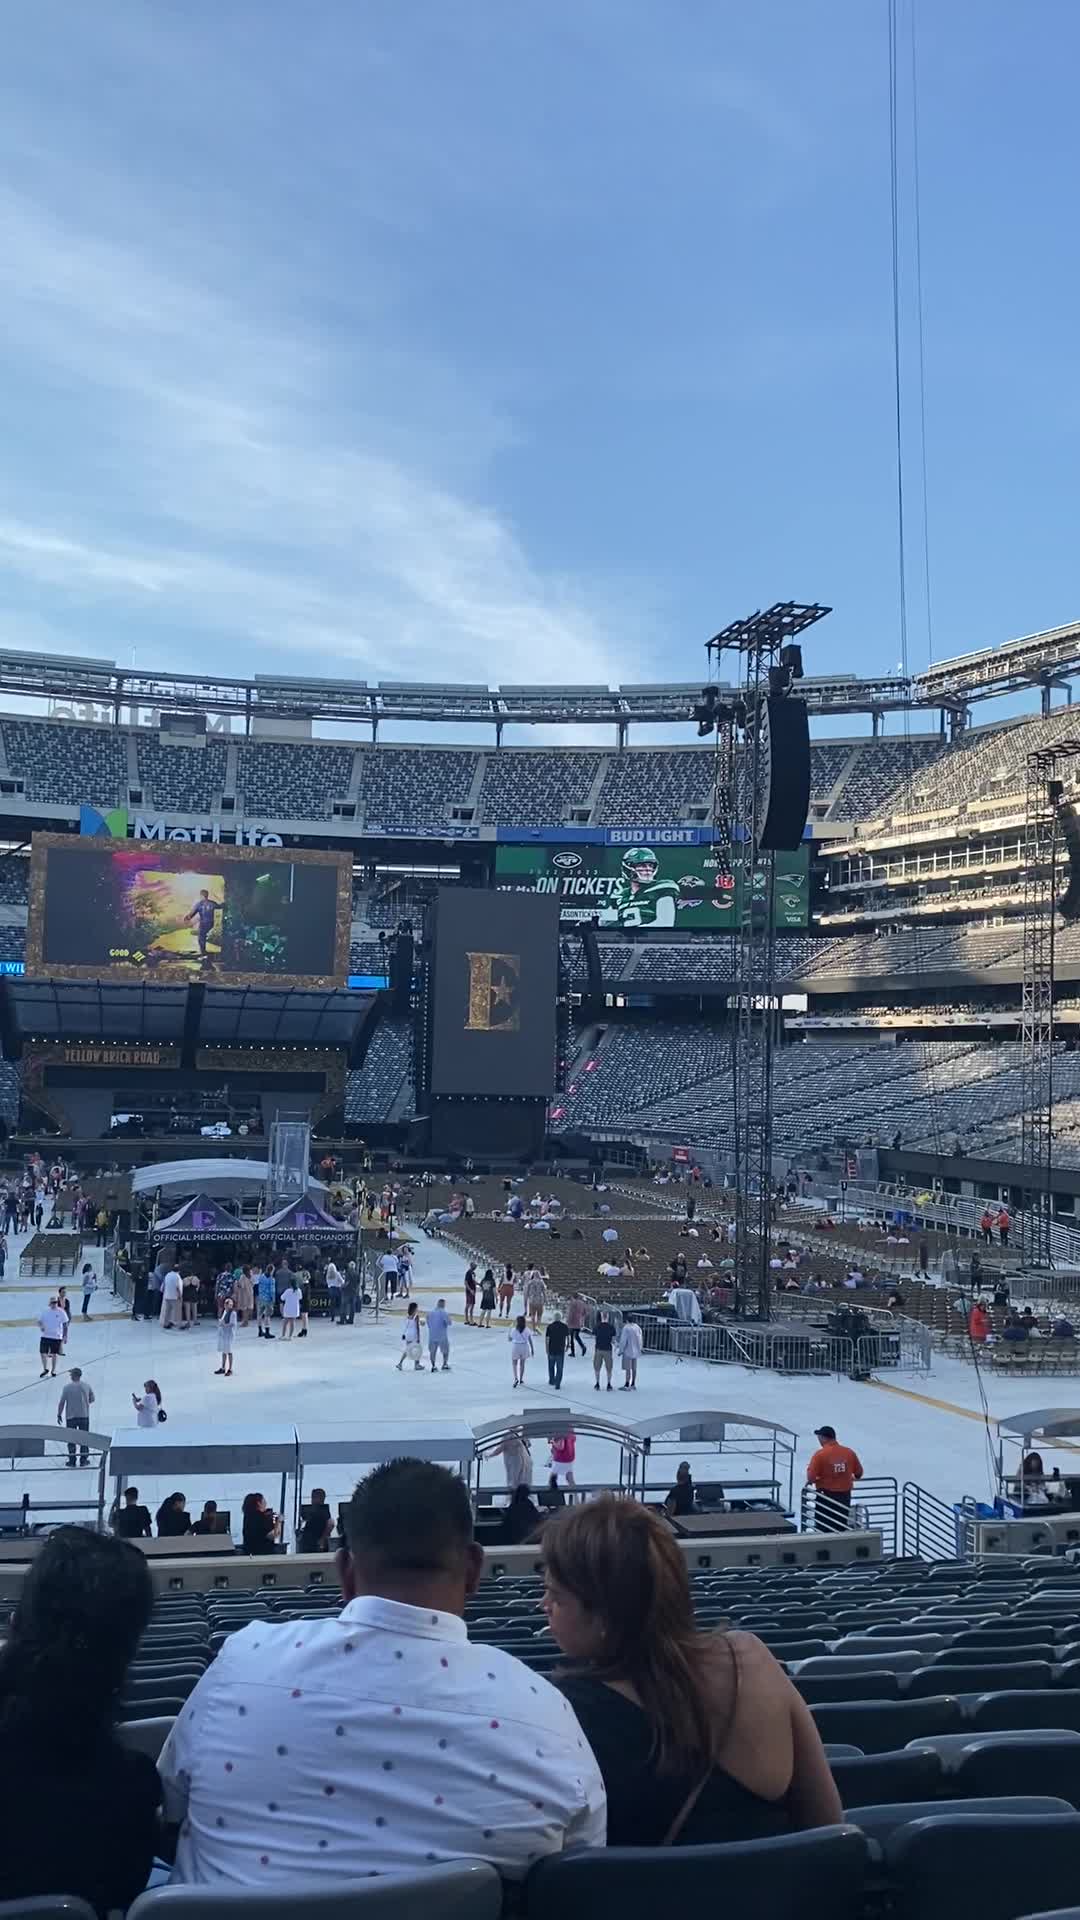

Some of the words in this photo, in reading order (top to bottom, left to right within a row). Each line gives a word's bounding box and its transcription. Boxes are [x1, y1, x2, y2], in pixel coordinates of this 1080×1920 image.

[134, 816, 284, 847] MetLife
[610, 830, 644, 842] BUD
[646, 830, 694, 842] LIGHT
[562, 877, 625, 895] TICKETS
[65, 1049, 100, 1063] YELLOW
[103, 1050, 131, 1064] BRICK
[133, 1051, 160, 1065] ROAD
[153, 1234, 191, 1242] OFFICIAL
[259, 1233, 297, 1241] OFFICIAL
[298, 1233, 355, 1241] MERCHANDISE
